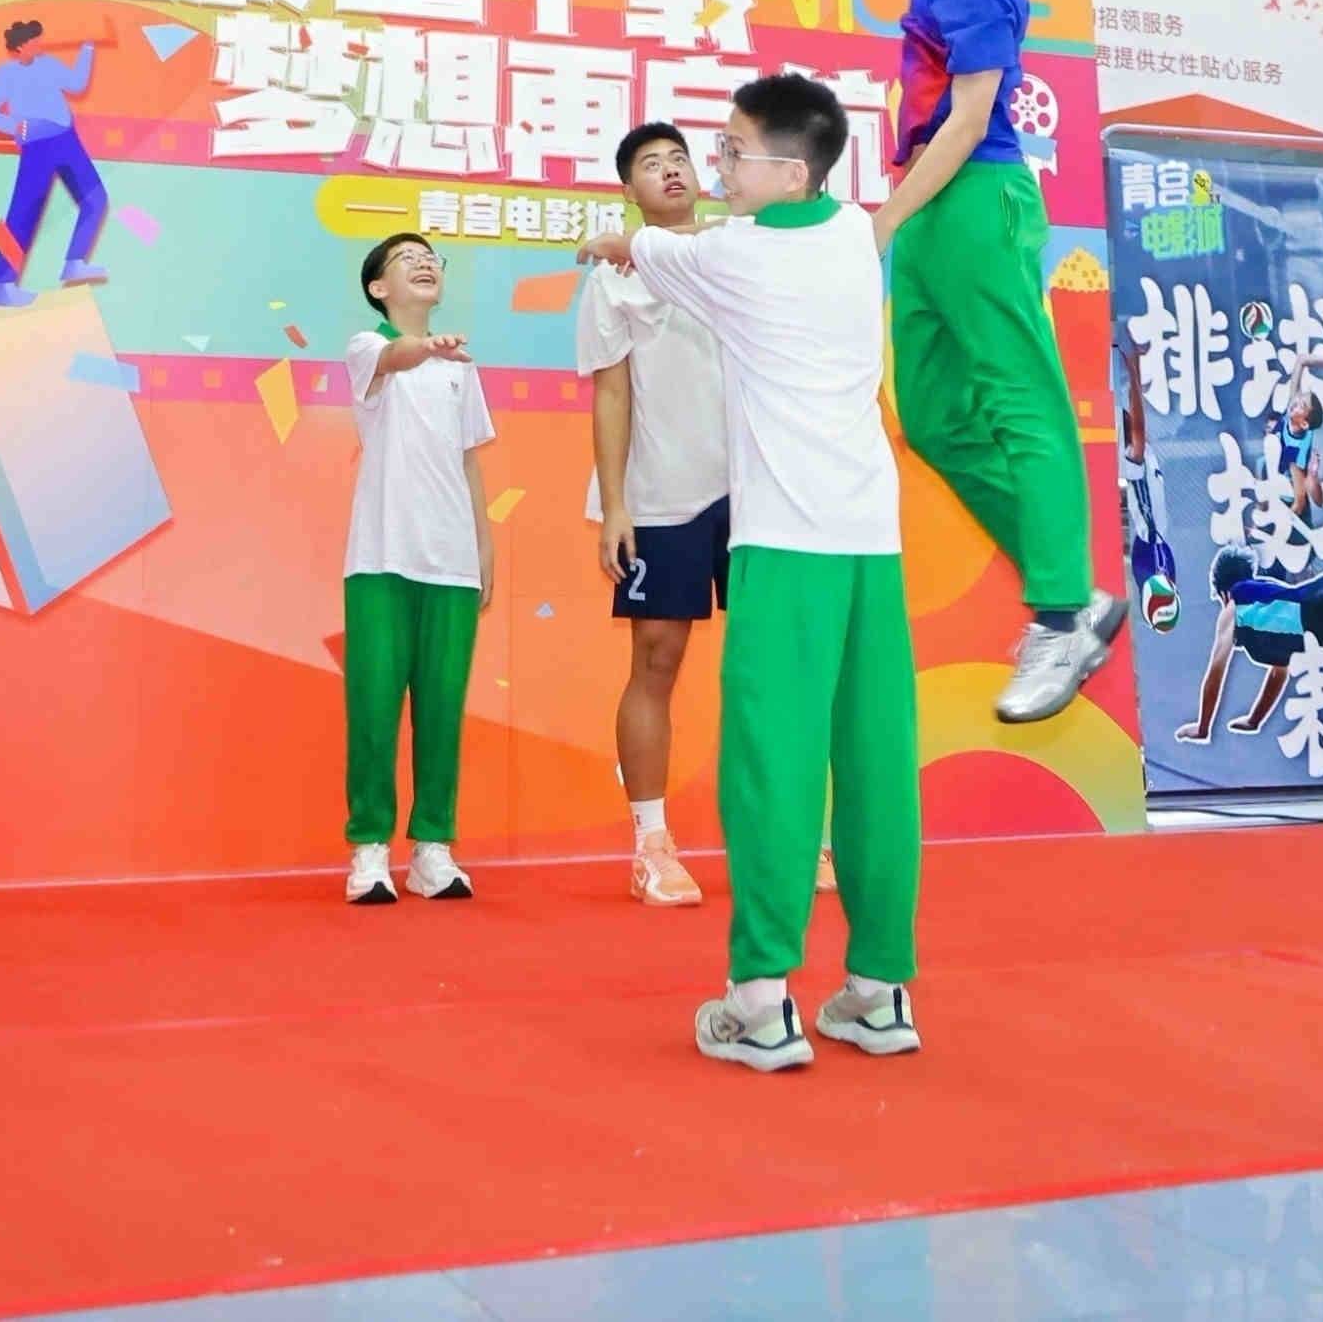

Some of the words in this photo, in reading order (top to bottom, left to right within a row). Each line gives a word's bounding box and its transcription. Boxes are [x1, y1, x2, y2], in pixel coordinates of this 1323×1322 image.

[1121, 160, 1190, 211] 青宫
[1141, 204, 1224, 261] 电影城
[627, 557, 647, 601] 2
